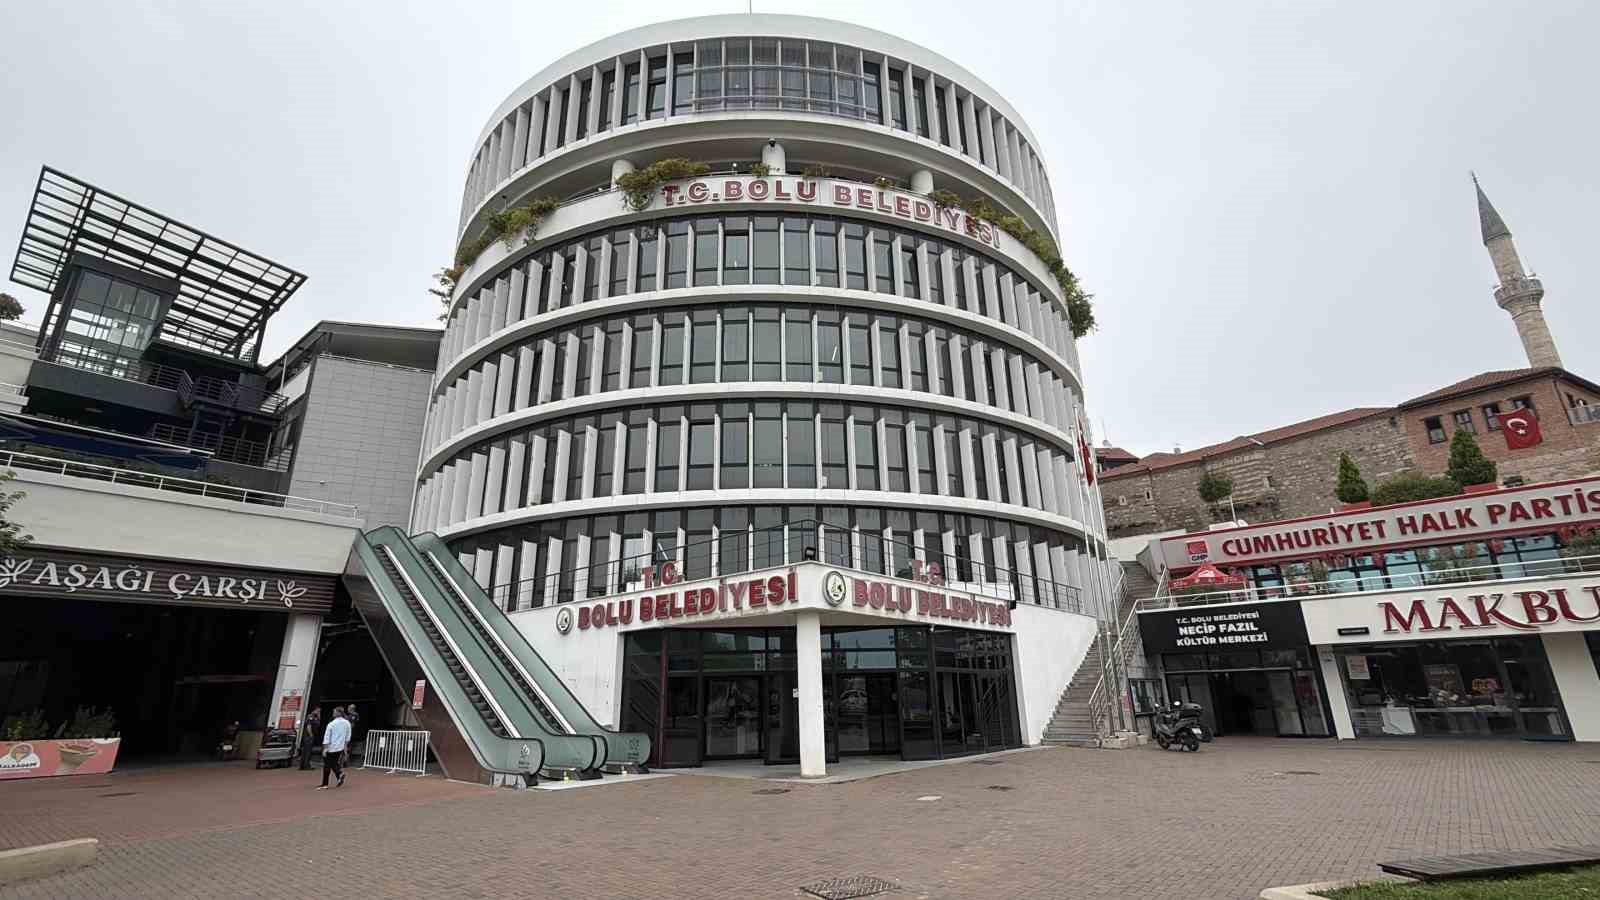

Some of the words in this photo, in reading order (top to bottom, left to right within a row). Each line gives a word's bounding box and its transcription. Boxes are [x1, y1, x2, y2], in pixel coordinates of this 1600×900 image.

[1221, 520, 1386, 557] CUMHURİYET
[1399, 506, 1481, 536] HALK
[31, 561, 154, 593] AŞAĞI
[167, 573, 269, 604] ÇARŞI
[577, 599, 633, 631] BOLU
[639, 566, 799, 622] BELEDİYESİ
[852, 578, 913, 614] BOLU
[1176, 617, 1190, 625] T.C.
[1191, 615, 1212, 624] BOLU
[1213, 610, 1260, 621] BELEDİYESİ
[1178, 622, 1217, 636] NECİP
[1219, 621, 1259, 633] FAZIL
[1377, 585, 1600, 634] MAKBU
[1176, 636, 1217, 647] KÜLTÜR
[1219, 632, 1269, 644] MERKEZİ
